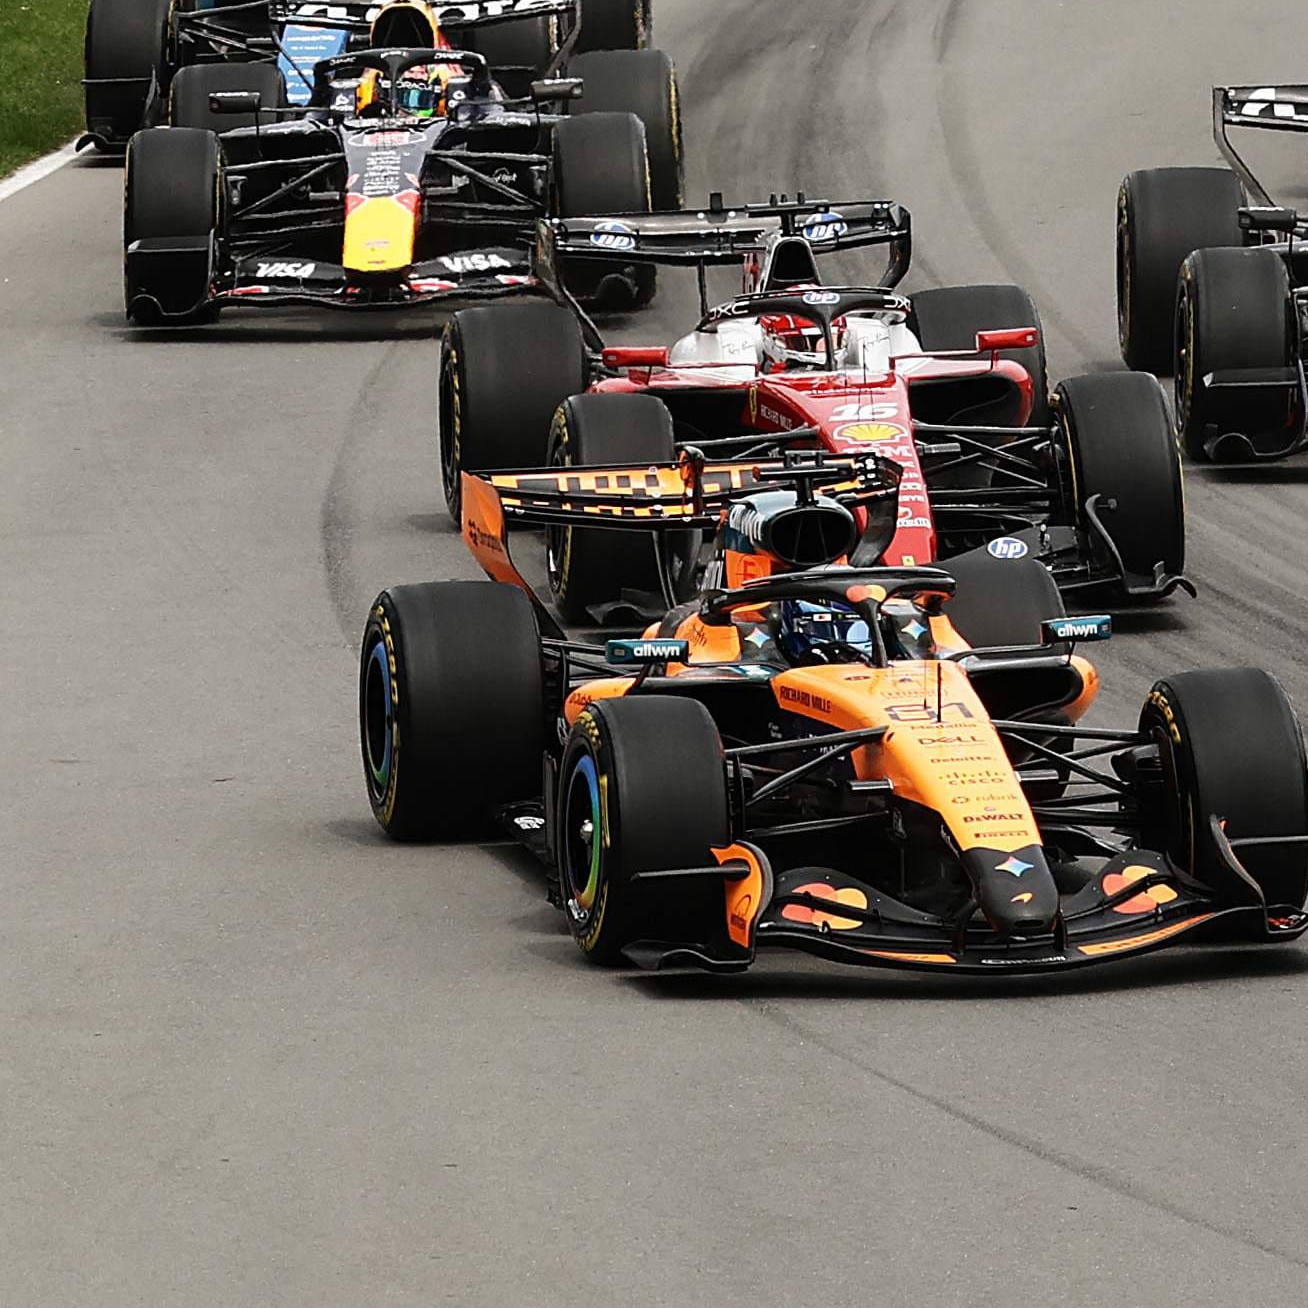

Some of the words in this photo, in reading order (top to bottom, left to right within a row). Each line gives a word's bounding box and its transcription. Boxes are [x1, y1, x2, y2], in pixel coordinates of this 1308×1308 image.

[256, 262, 316, 278] VISA
[439, 254, 512, 273] VISA
[828, 403, 898, 422] 16
[1057, 622, 1098, 638] allwyn
[633, 643, 680, 659] allwyn
[780, 686, 810, 708] RICHARD
[810, 695, 832, 713] MILLE
